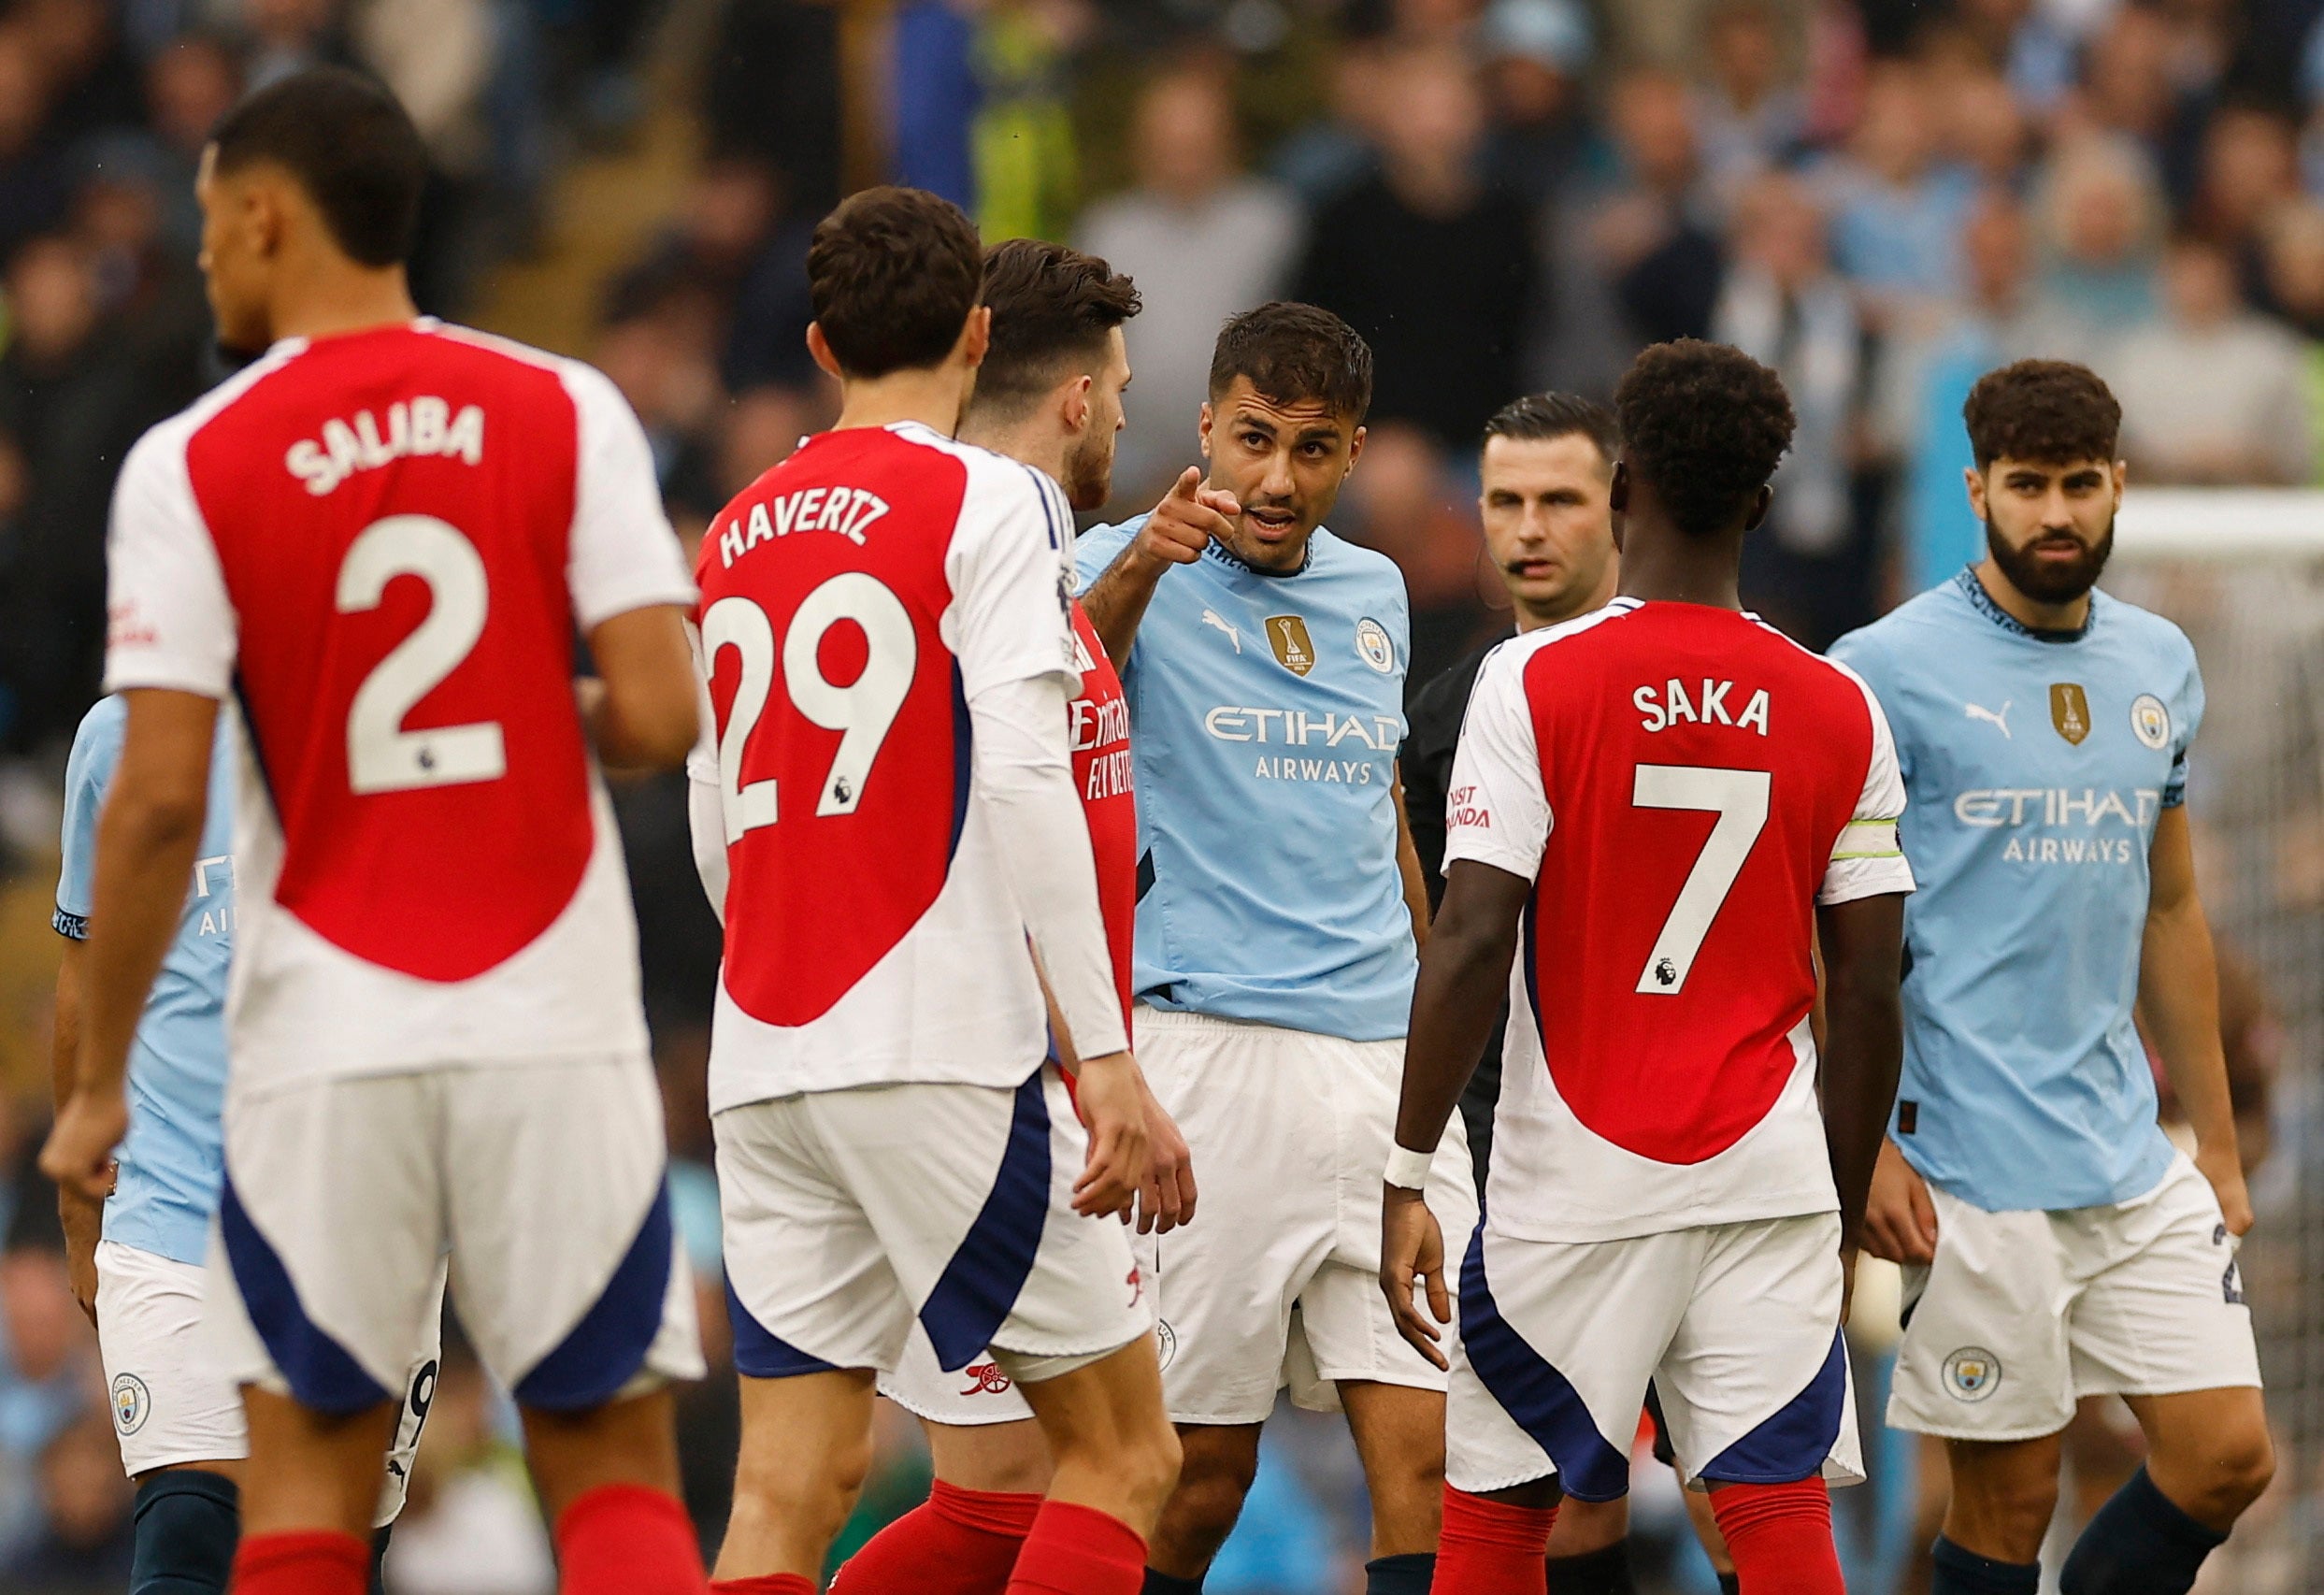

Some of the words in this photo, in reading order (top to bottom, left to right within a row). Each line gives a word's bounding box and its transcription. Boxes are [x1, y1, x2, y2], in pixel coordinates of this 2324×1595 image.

[285, 395, 485, 496] SALIBA
[719, 485, 891, 570] HAVERTZ
[334, 513, 507, 796] 2
[700, 570, 918, 848] 29
[1204, 705, 1401, 752] ETIHAD
[1632, 677, 1771, 737] SAKA
[1086, 754, 1110, 801] FLY
[1254, 755, 1371, 785] AIRWAYS
[1631, 763, 1772, 996] 7
[2002, 837, 2131, 864] AIRWAYS
